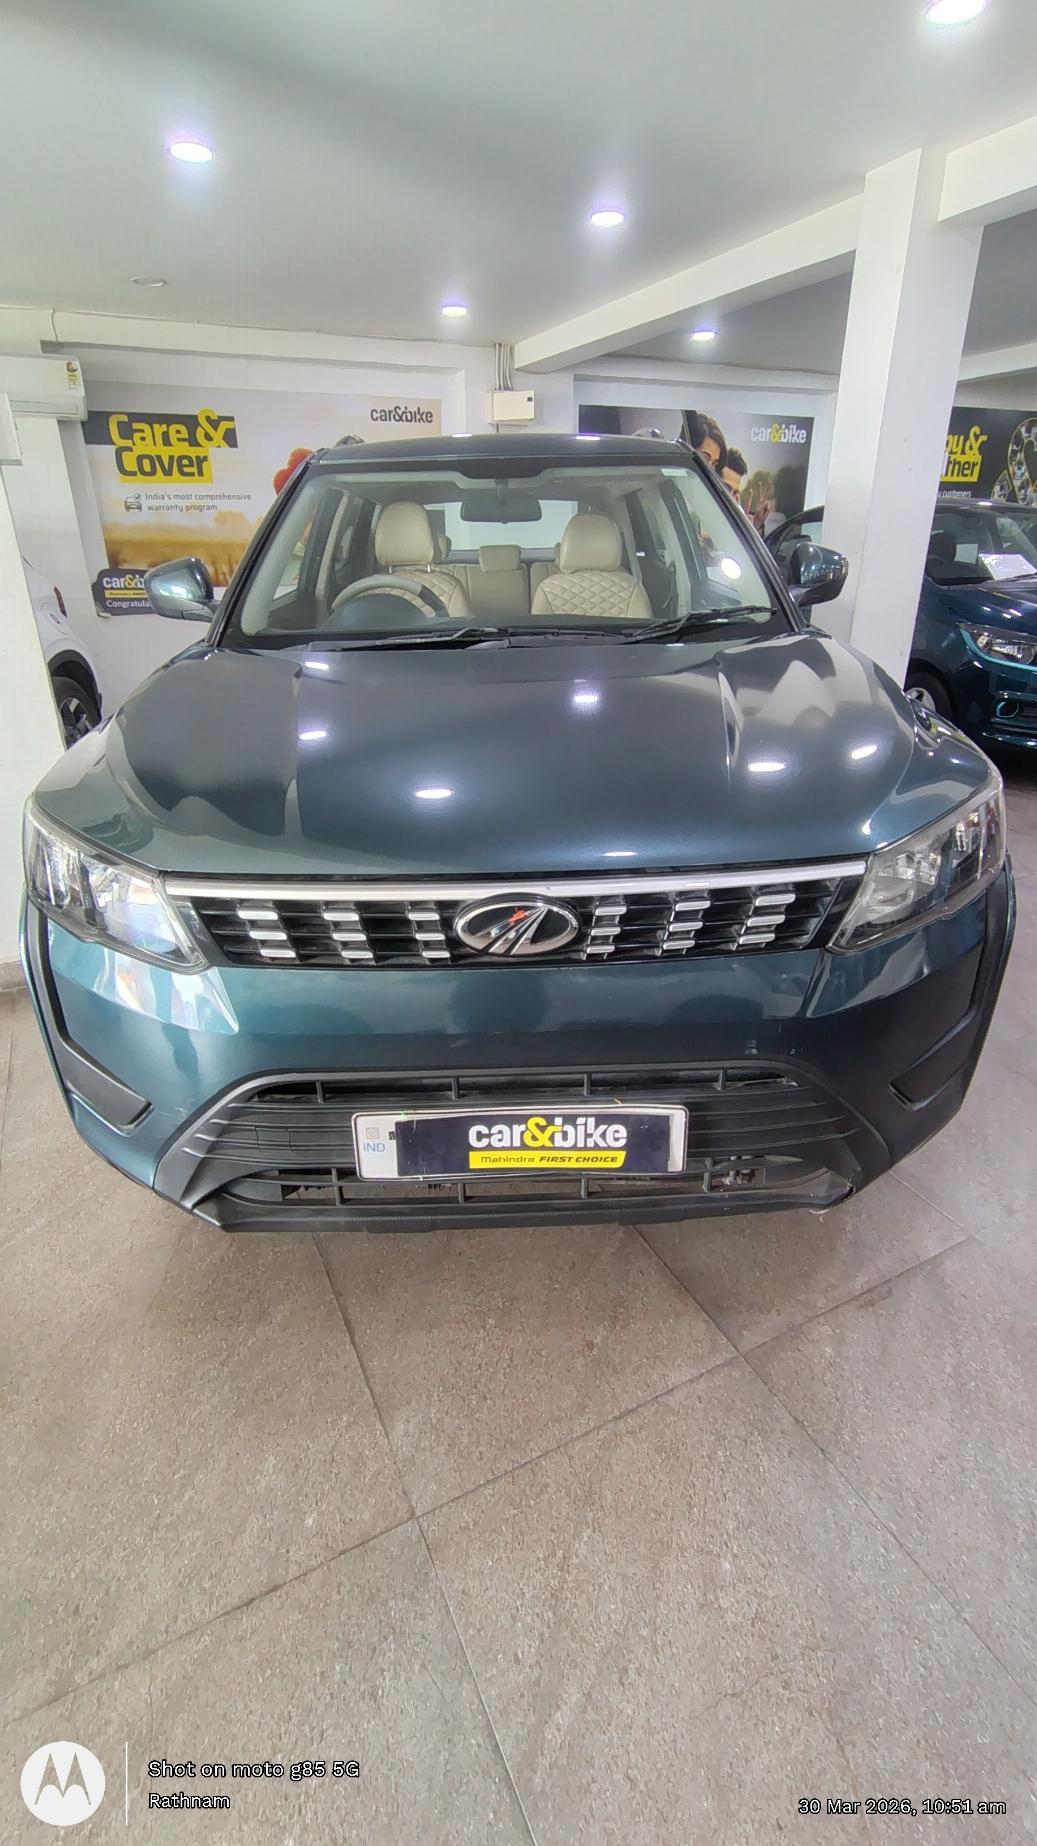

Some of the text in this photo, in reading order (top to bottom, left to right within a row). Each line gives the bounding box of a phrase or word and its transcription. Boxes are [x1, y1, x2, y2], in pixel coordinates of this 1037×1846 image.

[370, 405, 434, 424] car&bike
[108, 408, 235, 448] Care &
[751, 423, 807, 444] car&bike
[966, 425, 988, 455] &
[115, 446, 208, 477] Cover
[145, 492, 252, 502] India's most comprehensive
[147, 504, 218, 512] warranty program
[106, 600, 152, 609] Congratula
[468, 1116, 627, 1148] car&bike
[363, 1142, 386, 1153] IND
